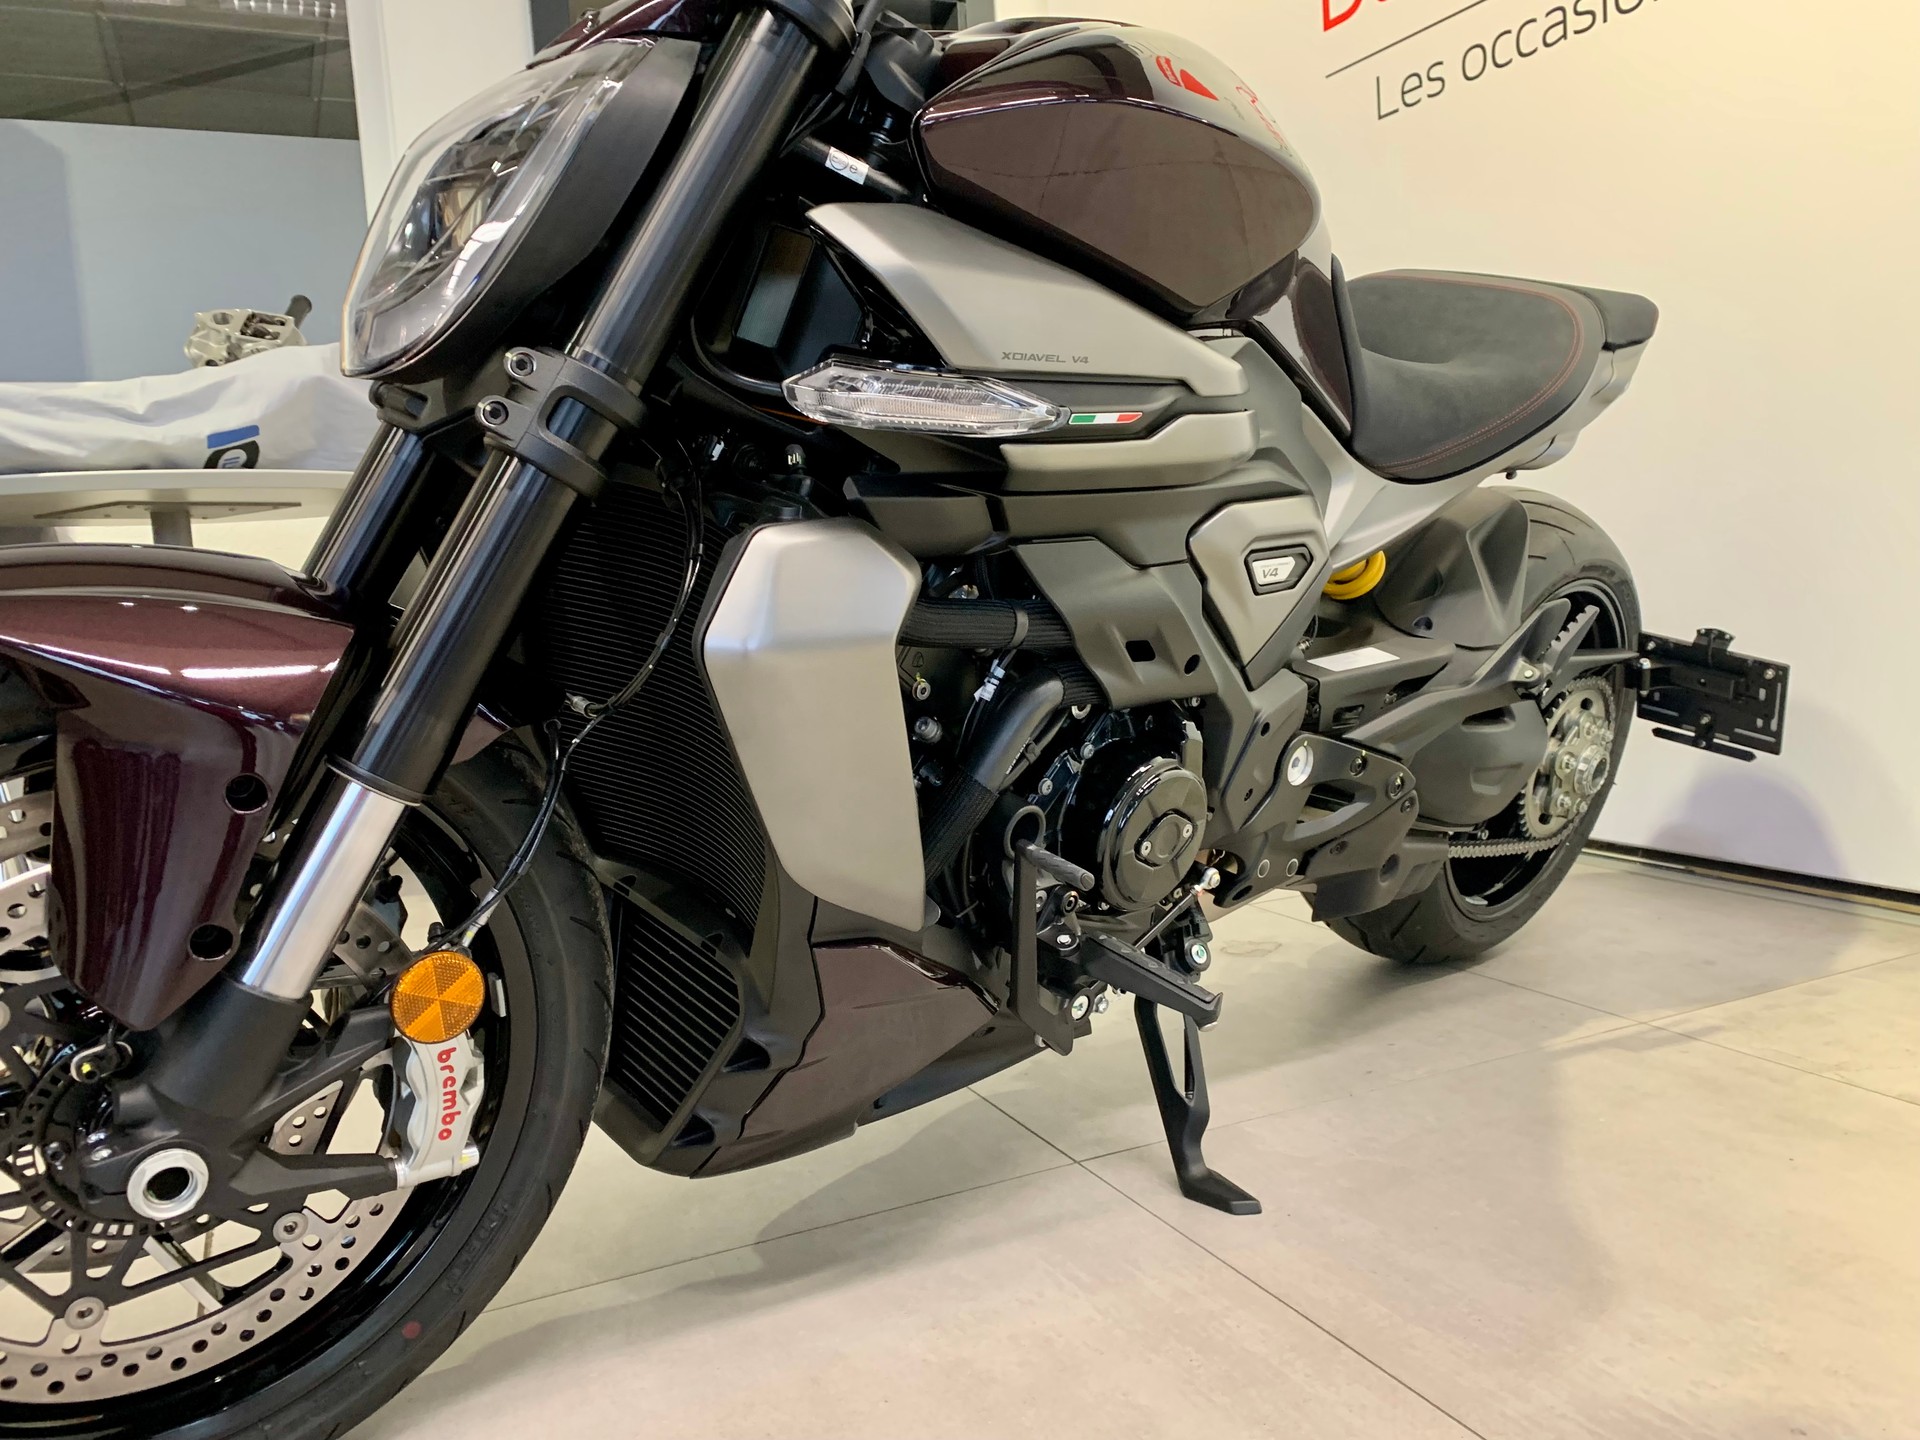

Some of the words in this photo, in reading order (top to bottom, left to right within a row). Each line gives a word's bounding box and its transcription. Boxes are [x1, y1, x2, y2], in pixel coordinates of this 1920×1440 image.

[1376, 60, 1446, 121] Les
[1001, 351, 1067, 364] XDIAVEL
[1072, 355, 1089, 364] V4
[1262, 568, 1279, 579] V4
[437, 1046, 462, 1142] brembo
